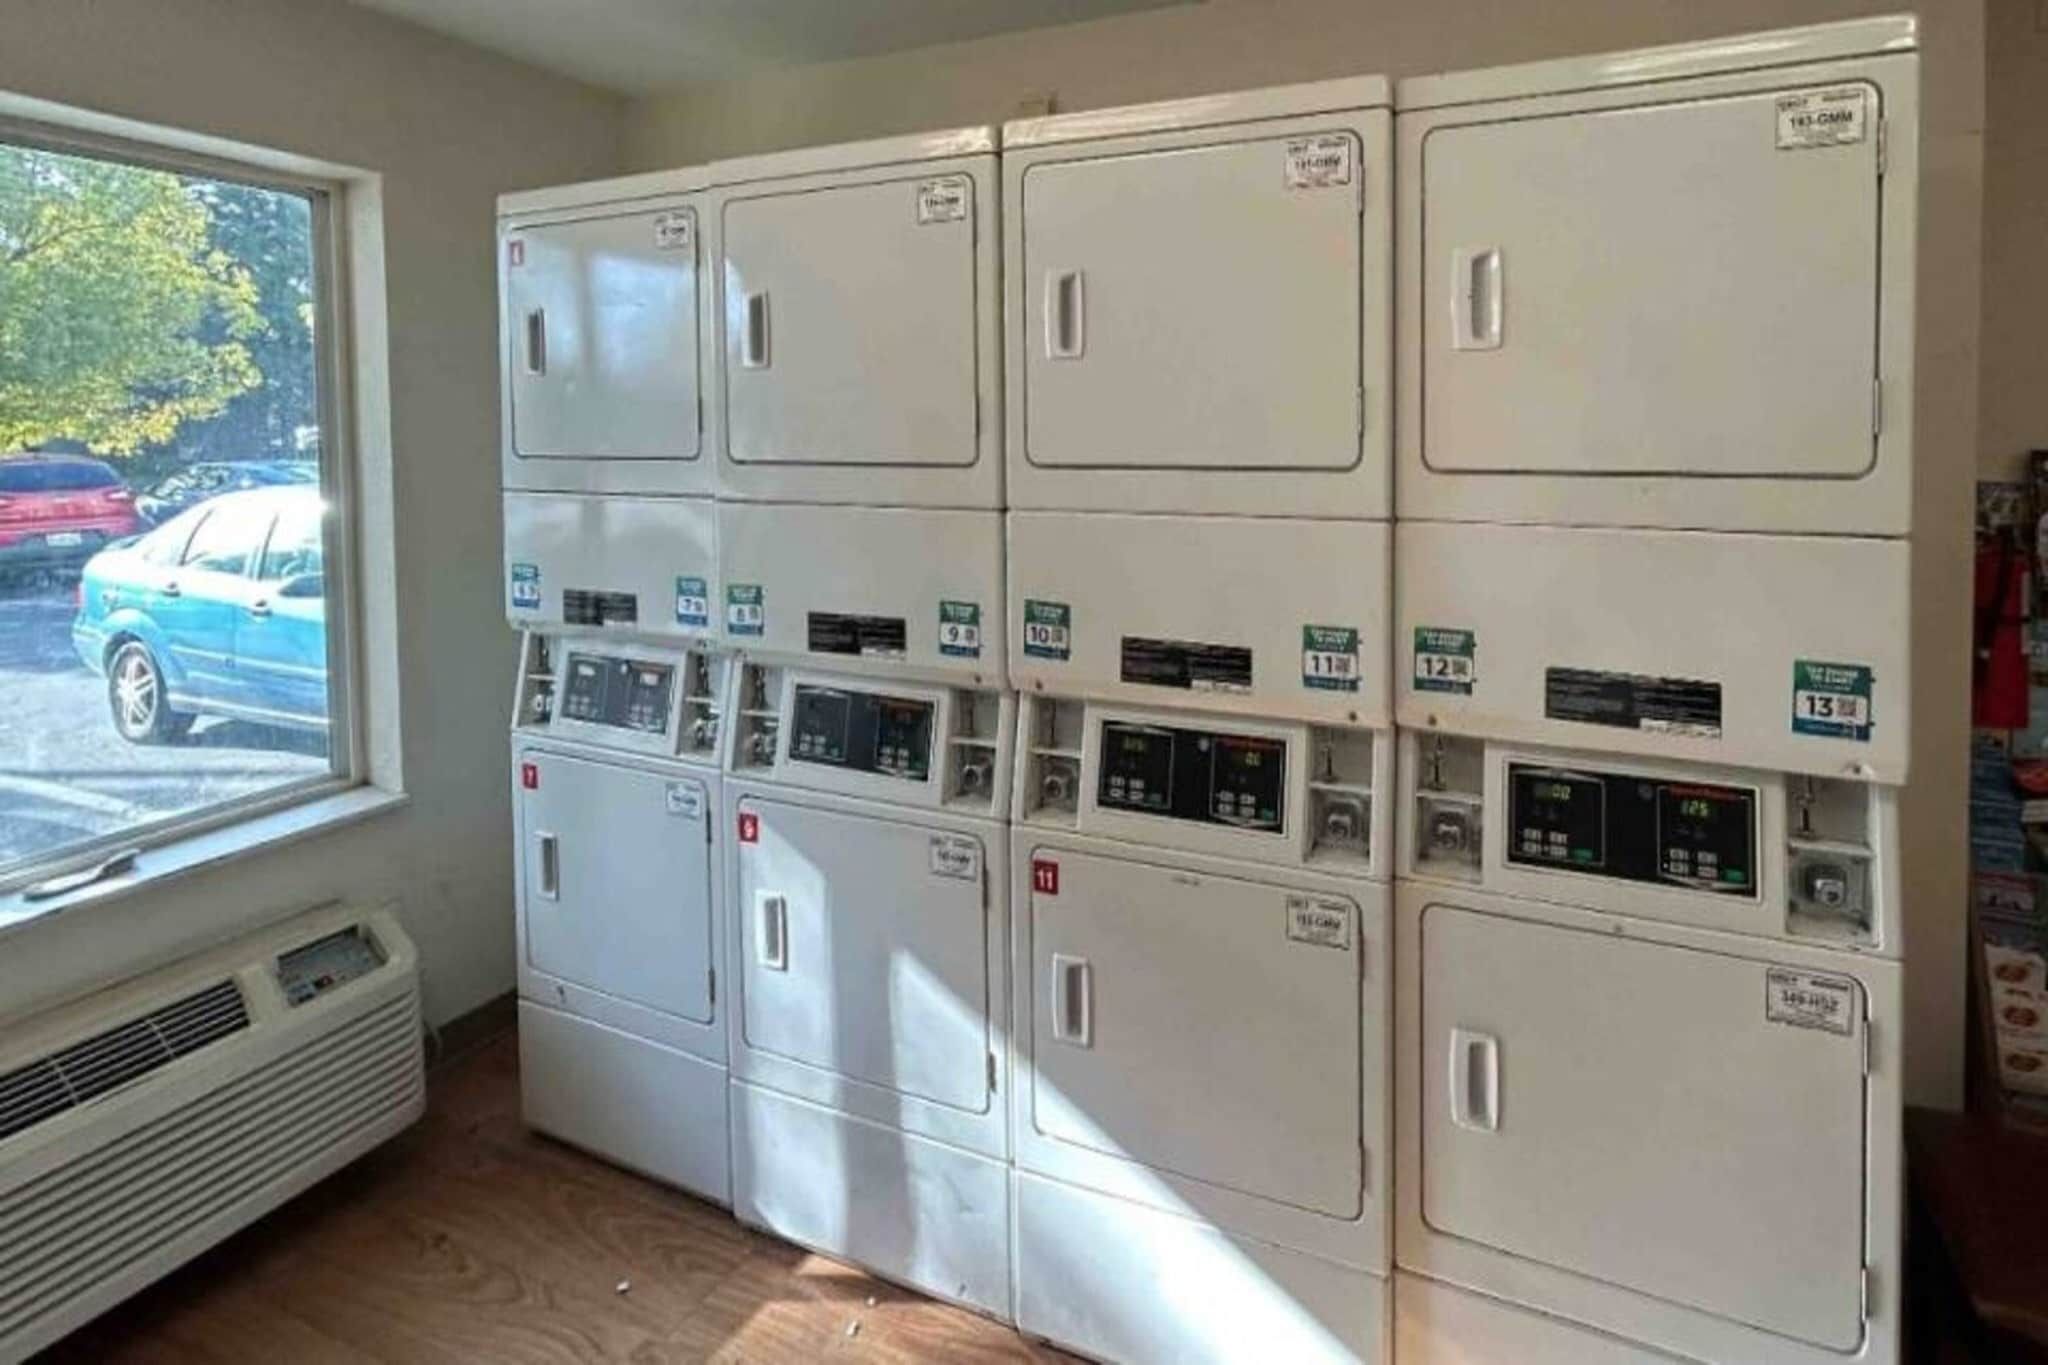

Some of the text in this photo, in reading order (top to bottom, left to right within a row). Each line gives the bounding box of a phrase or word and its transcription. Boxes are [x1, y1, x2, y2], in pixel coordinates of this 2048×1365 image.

[949, 626, 959, 642] 9
[1031, 626, 1049, 643] 10
[1312, 655, 1332, 673] 11
[1425, 657, 1449, 676] 12
[1806, 695, 1833, 717] 13
[1037, 869, 1053, 890] 11
